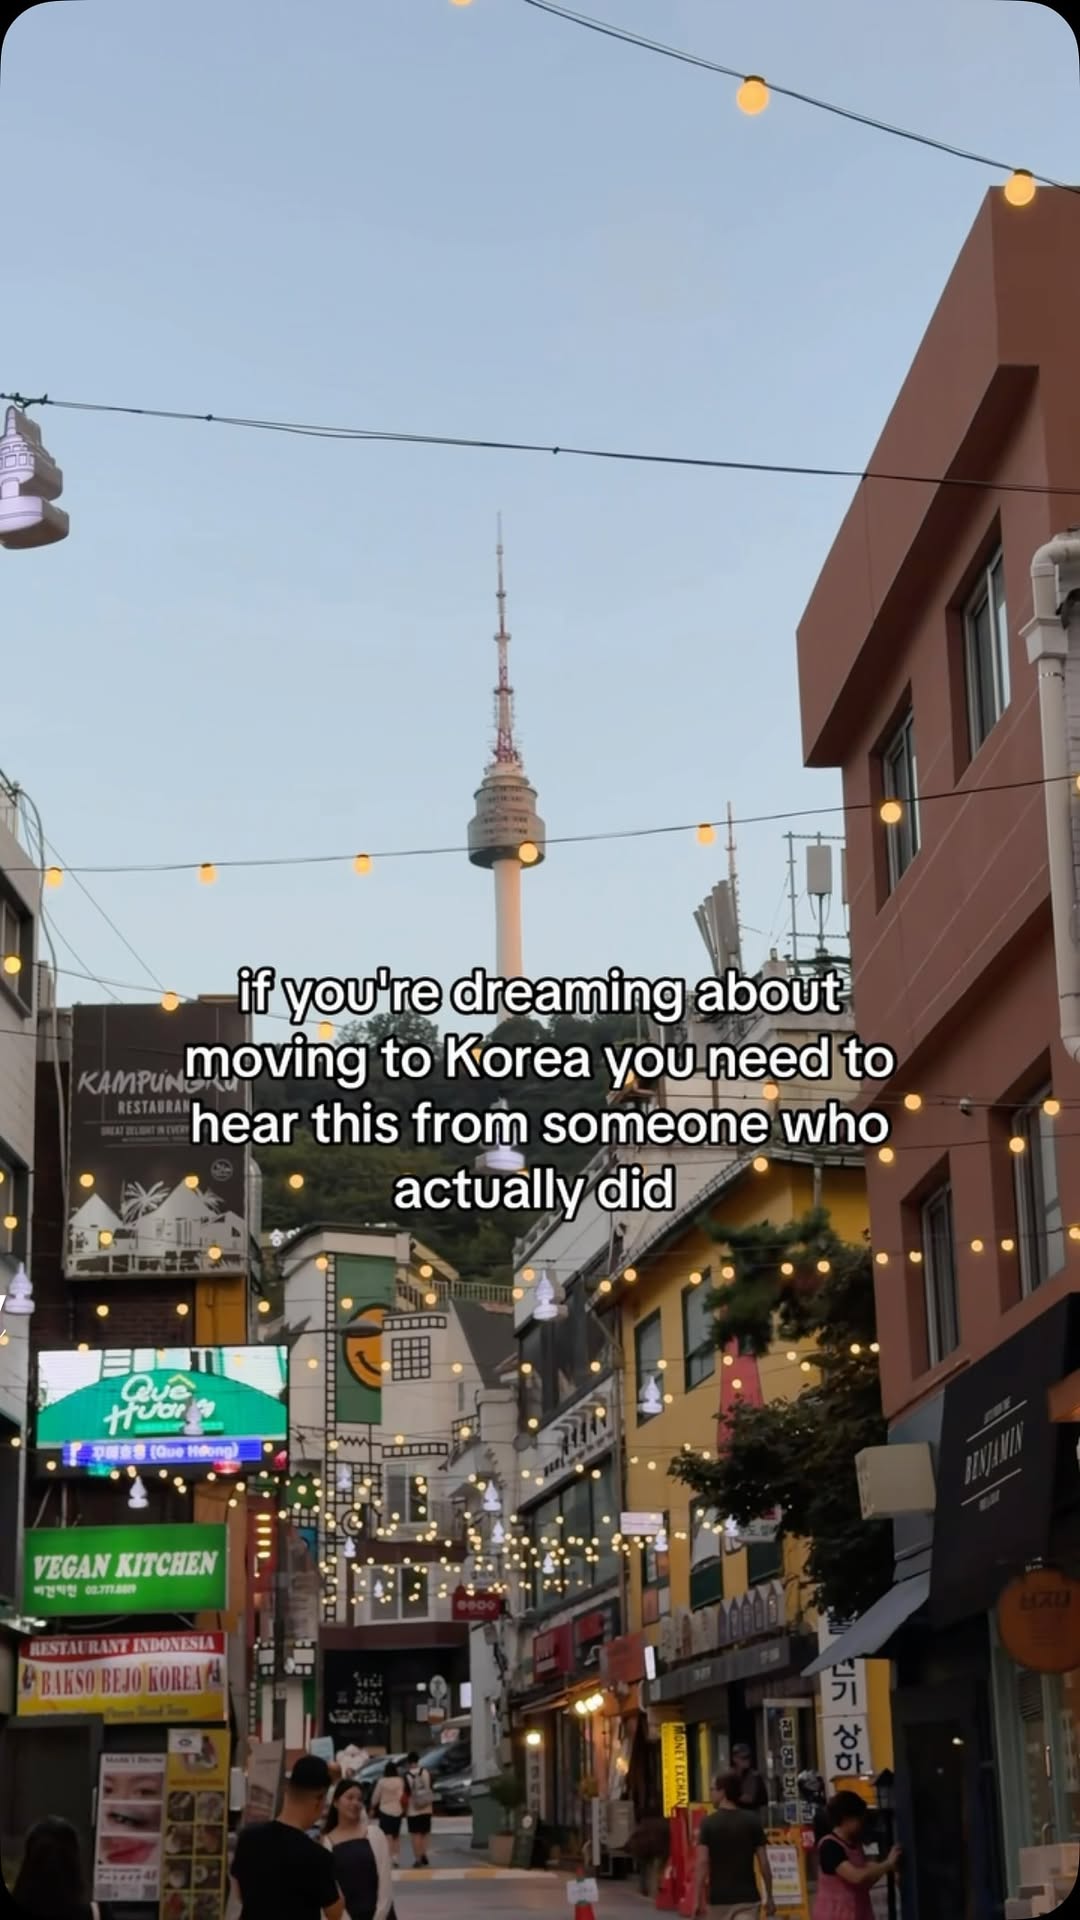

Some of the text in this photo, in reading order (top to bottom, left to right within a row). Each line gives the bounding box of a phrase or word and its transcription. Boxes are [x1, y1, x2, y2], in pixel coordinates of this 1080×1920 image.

[118, 1099, 193, 1116] RESTAURAN
[964, 1420, 1024, 1486] BENJAMIN
[33, 1550, 219, 1581] VEGAN KITCHEN
[29, 1635, 215, 1658] RESTAURANT INDONESIA
[41, 1663, 202, 1696] BAKSO BEJO KOREA
[672, 1724, 687, 1806] MONEY EXCHAN
